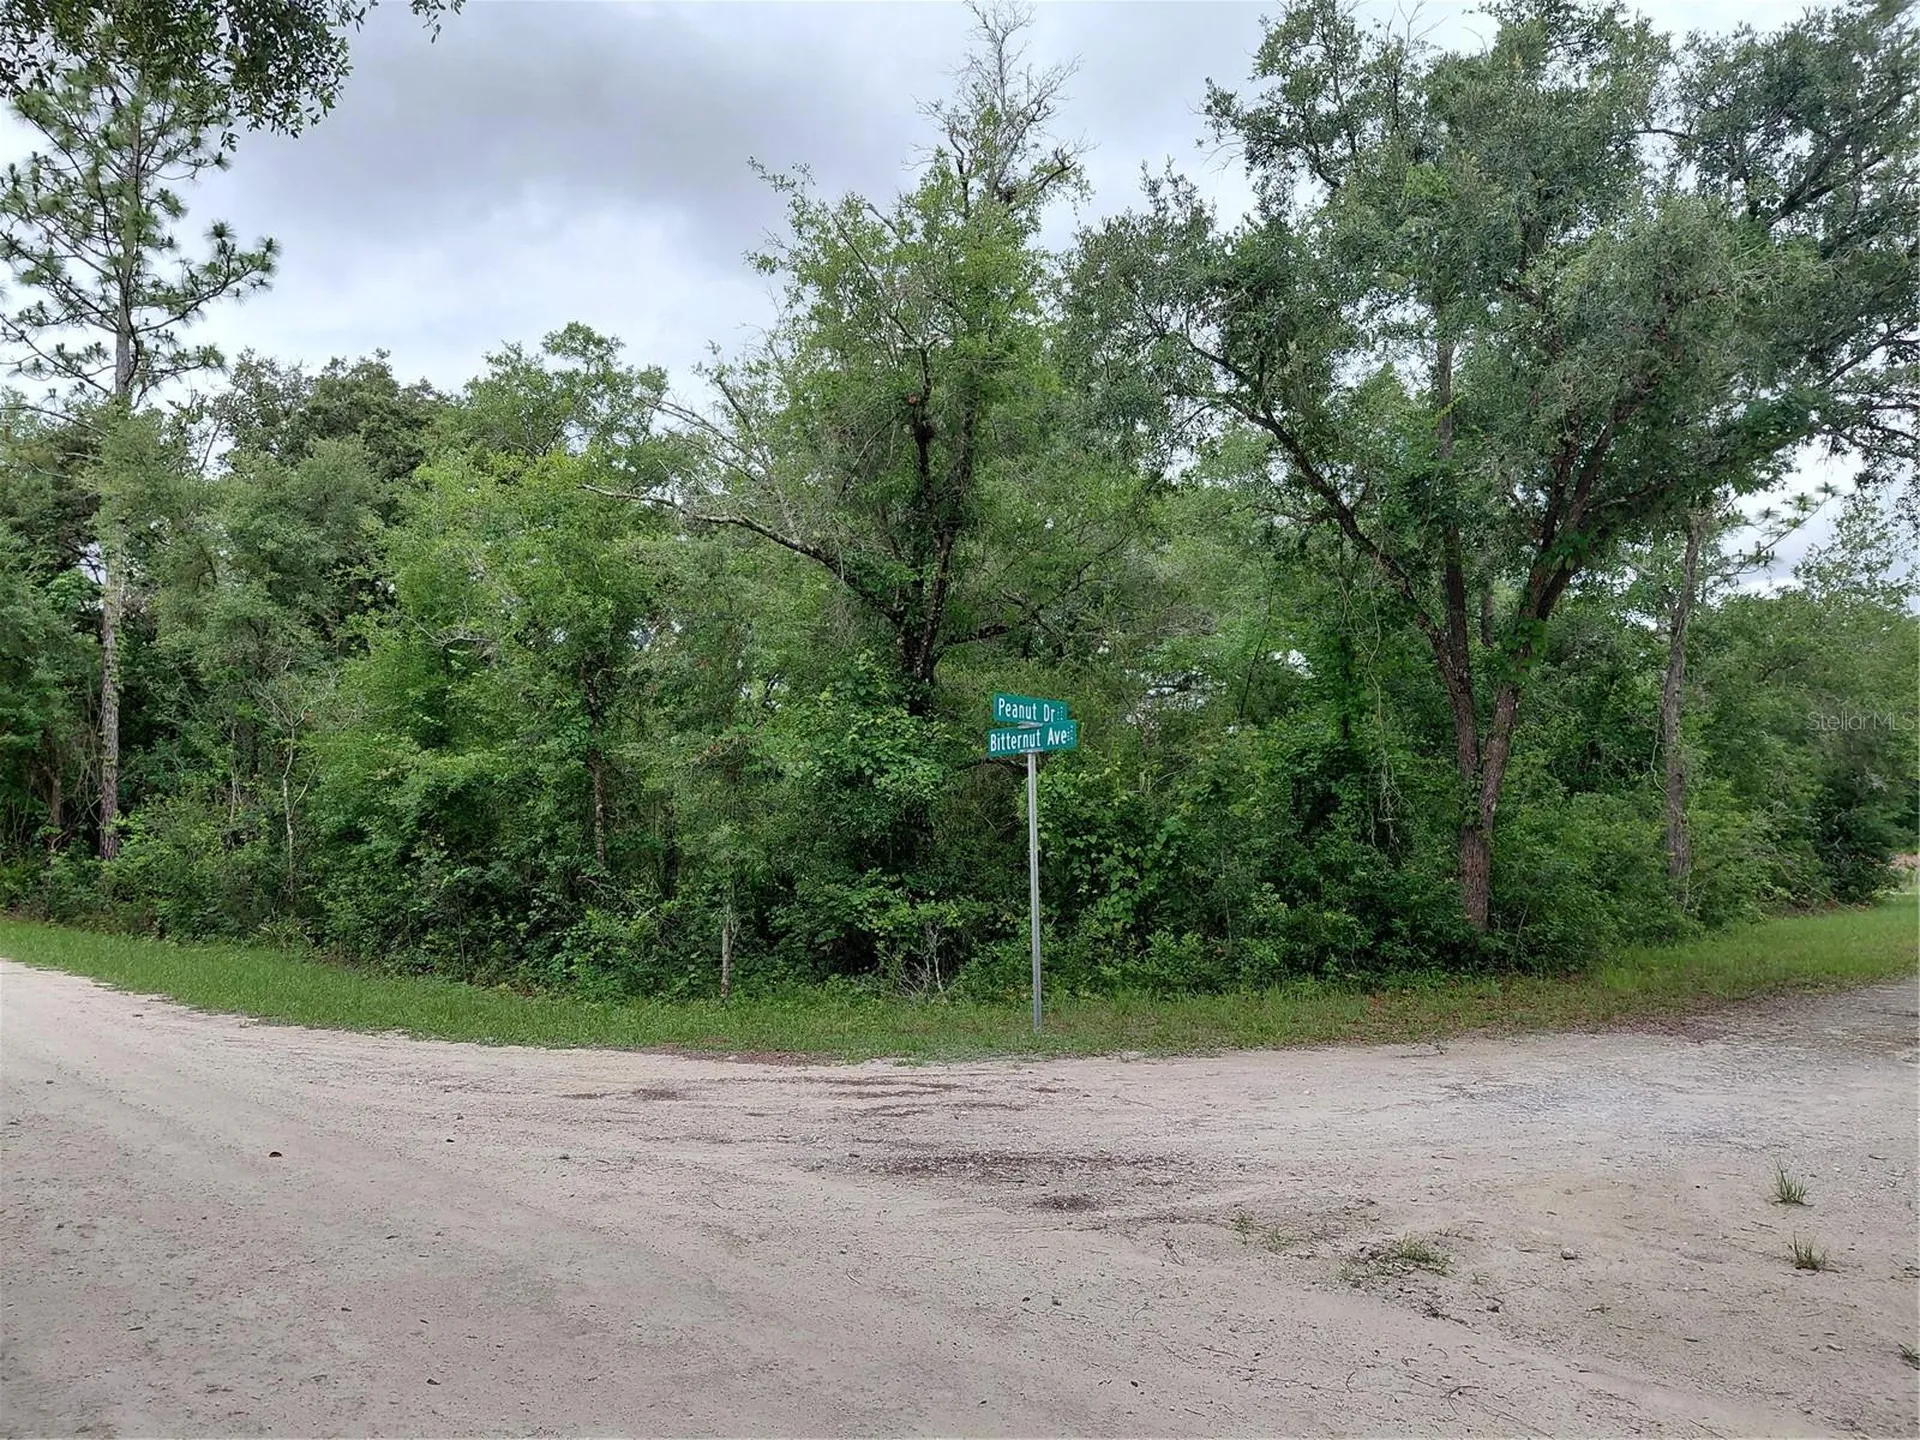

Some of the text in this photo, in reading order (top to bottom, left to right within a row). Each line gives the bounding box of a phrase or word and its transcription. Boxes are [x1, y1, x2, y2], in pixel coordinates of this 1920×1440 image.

[998, 697, 1037, 720] Peanut
[1043, 703, 1056, 722] Dr
[990, 728, 1041, 752] Bitternut
[1047, 727, 1067, 746] Ave
